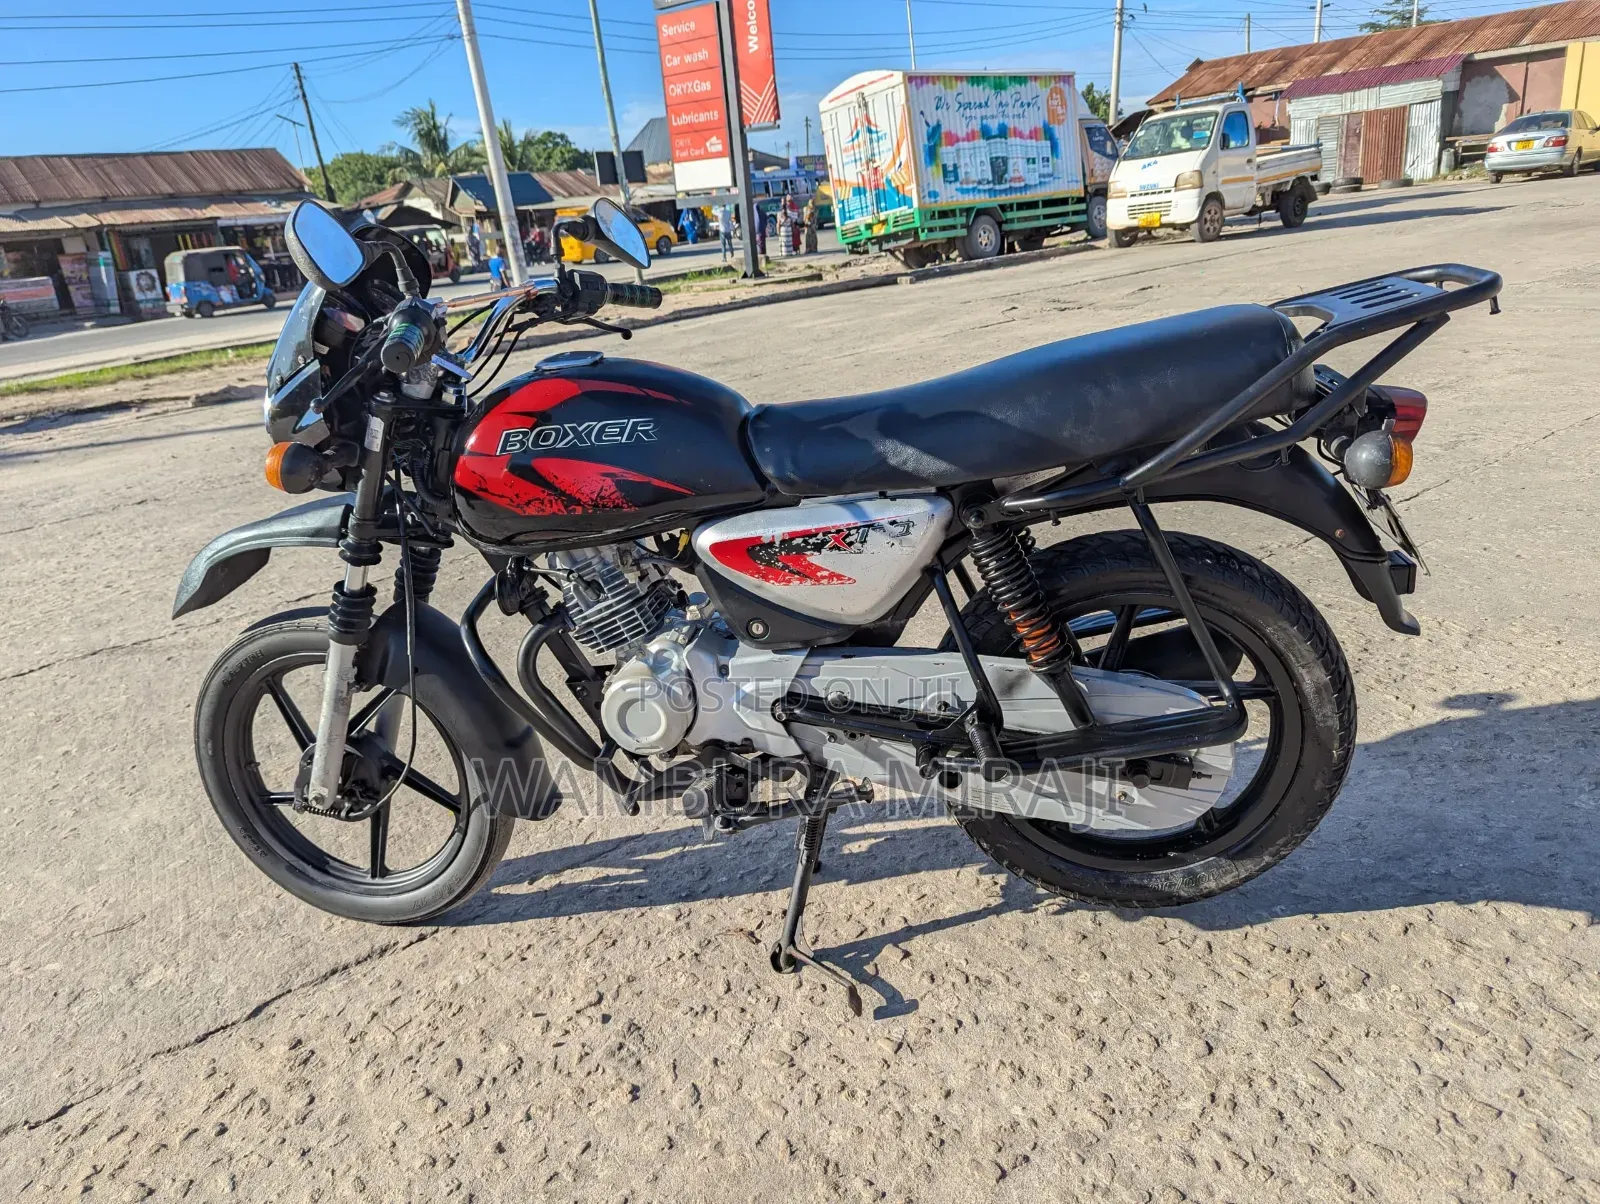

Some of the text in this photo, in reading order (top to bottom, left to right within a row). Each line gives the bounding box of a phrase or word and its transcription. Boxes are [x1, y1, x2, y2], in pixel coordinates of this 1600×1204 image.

[662, 21, 696, 37] Service
[665, 48, 709, 67] Car wash
[669, 80, 712, 96] ORYXGas
[672, 110, 719, 126] Lubricants
[675, 138, 692, 149] ORYX
[676, 147, 705, 158] Fuel Card
[496, 418, 663, 456] BOXER
